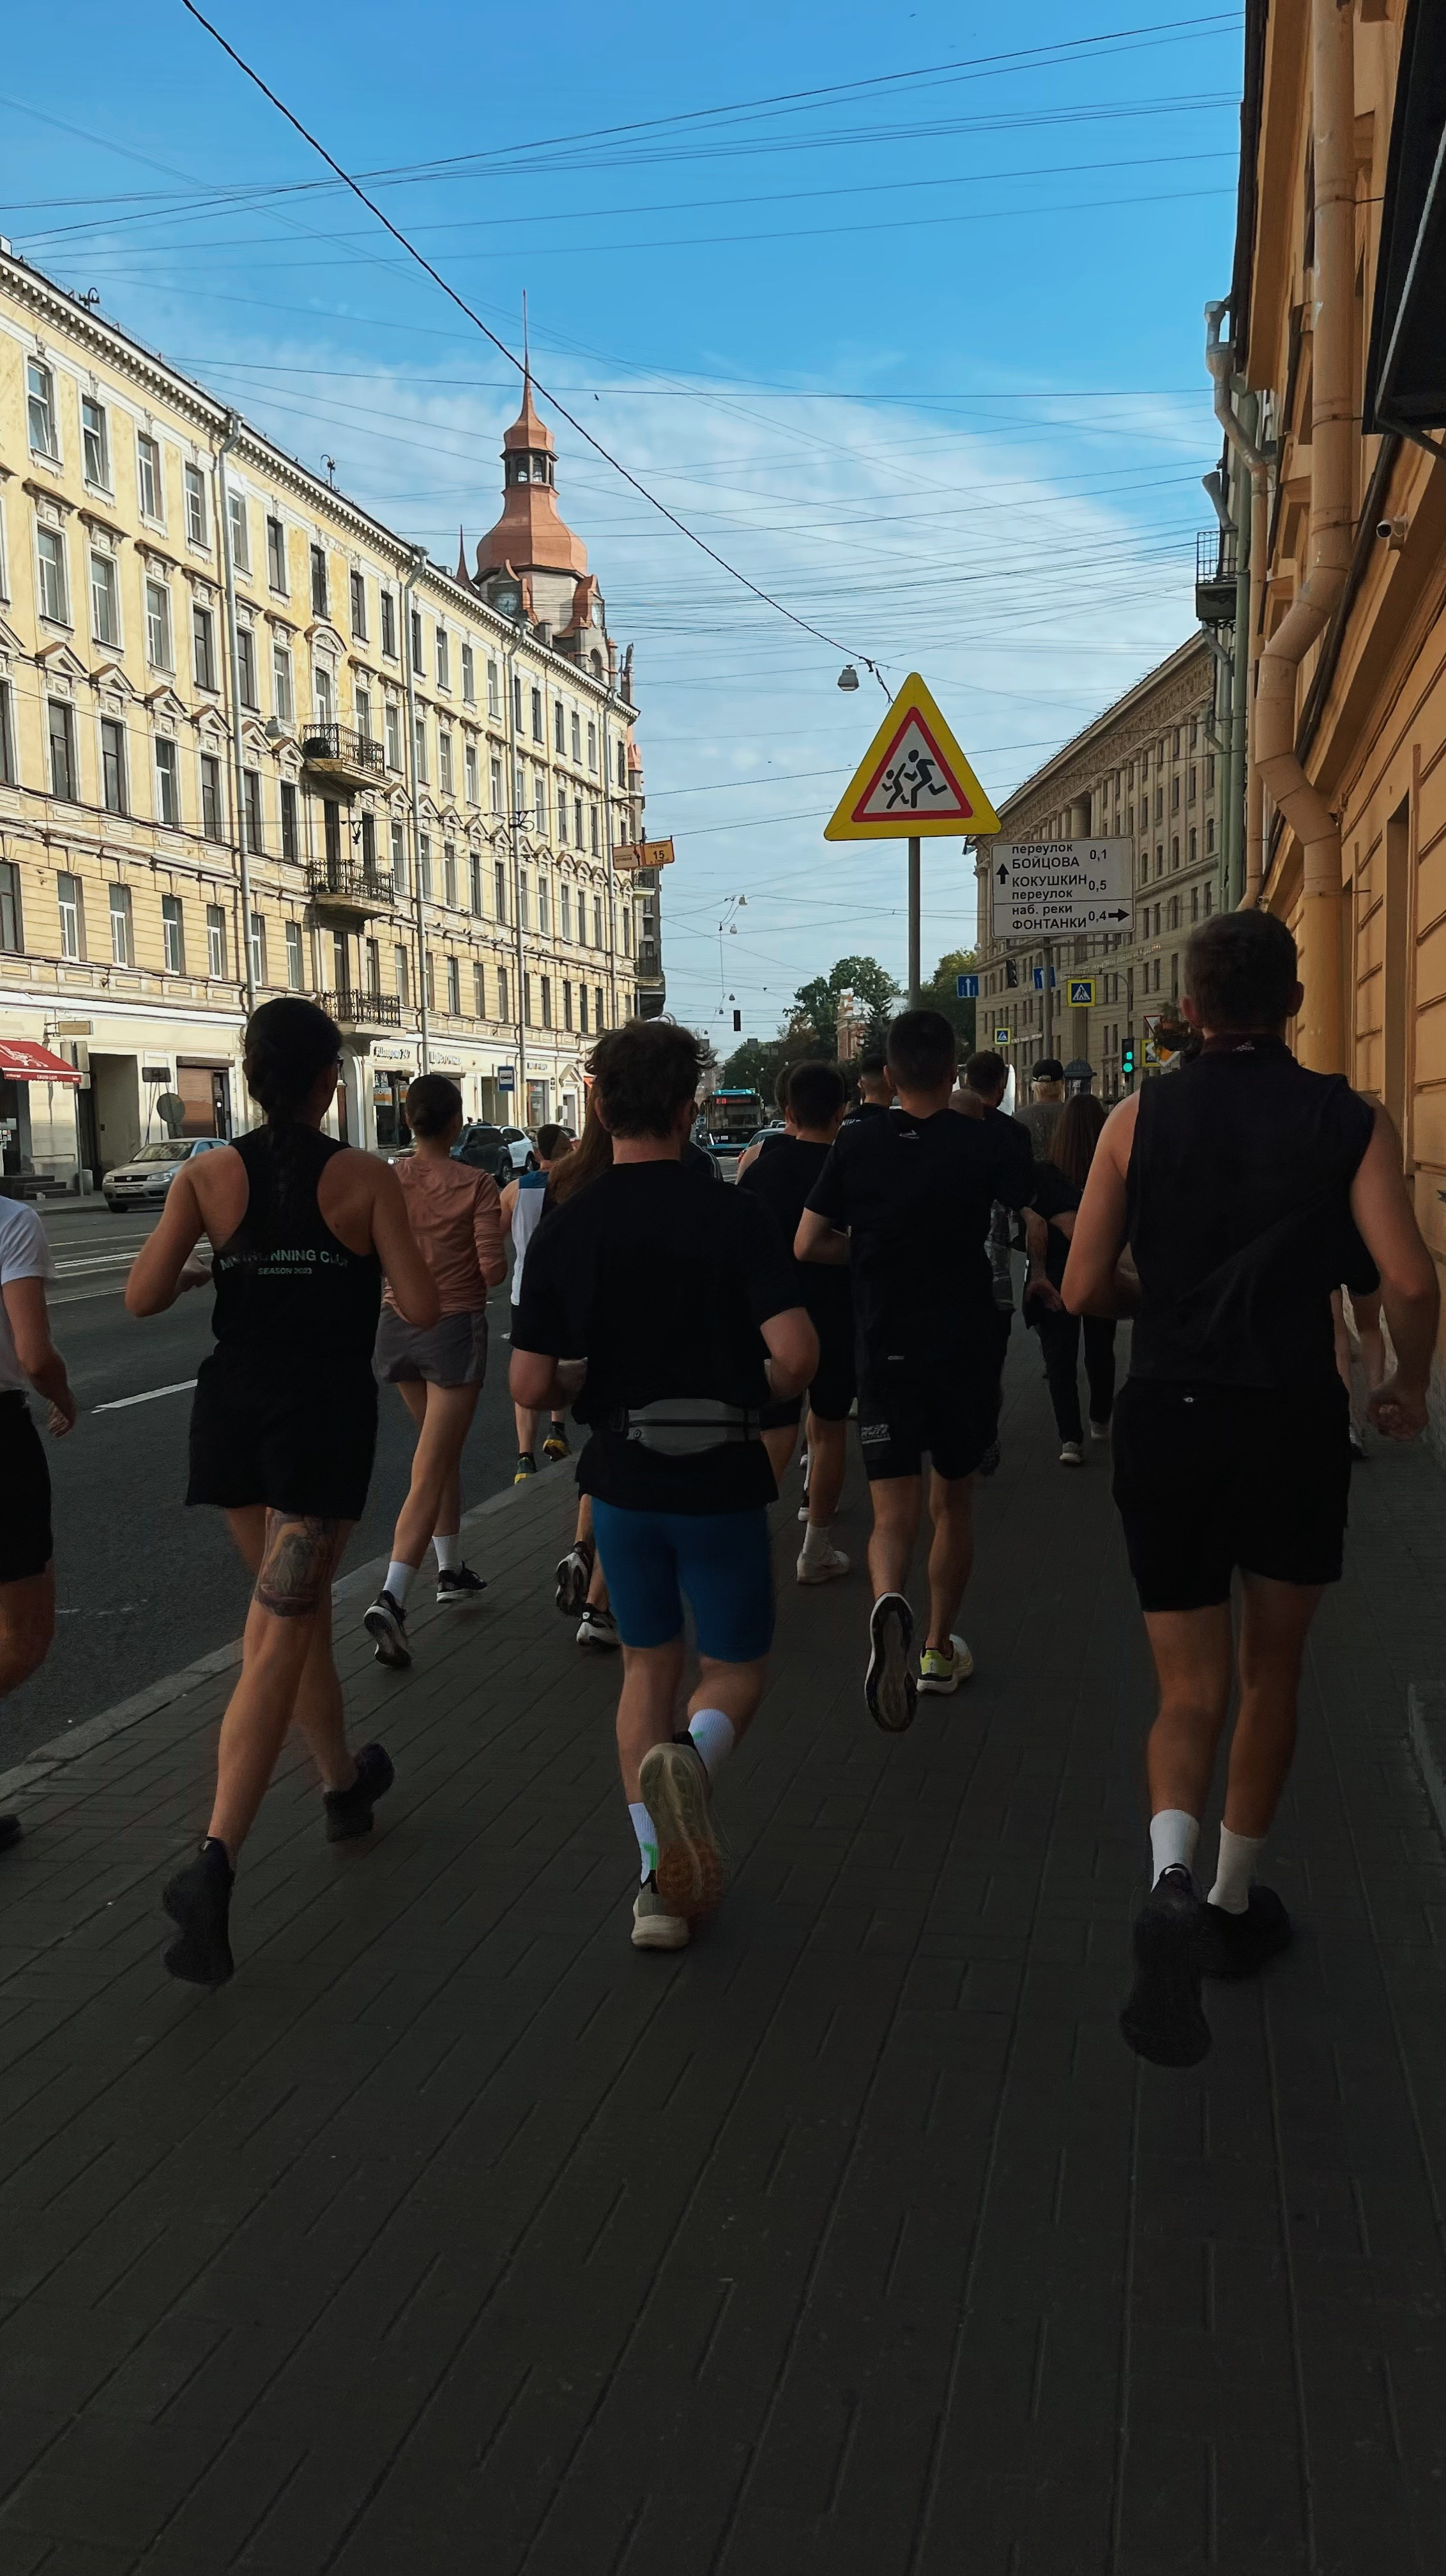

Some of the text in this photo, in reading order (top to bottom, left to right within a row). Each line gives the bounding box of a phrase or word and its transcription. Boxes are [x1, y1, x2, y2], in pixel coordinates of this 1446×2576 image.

[653, 850, 665, 859] 15
[1012, 843, 1073, 855] переулок
[1090, 849, 1107, 861] 0,1
[1012, 856, 1079, 870] БОЙЦОВА
[1012, 874, 1087, 887] КОКУШКИН
[1088, 880, 1107, 893] 0,5
[1012, 889, 1073, 901] переулок
[1012, 904, 1072, 916] наб. реки
[1088, 910, 1107, 923] 0,4
[1012, 917, 1086, 930] ФОНТАНКИ
[258, 1267, 292, 1275] SEASON
